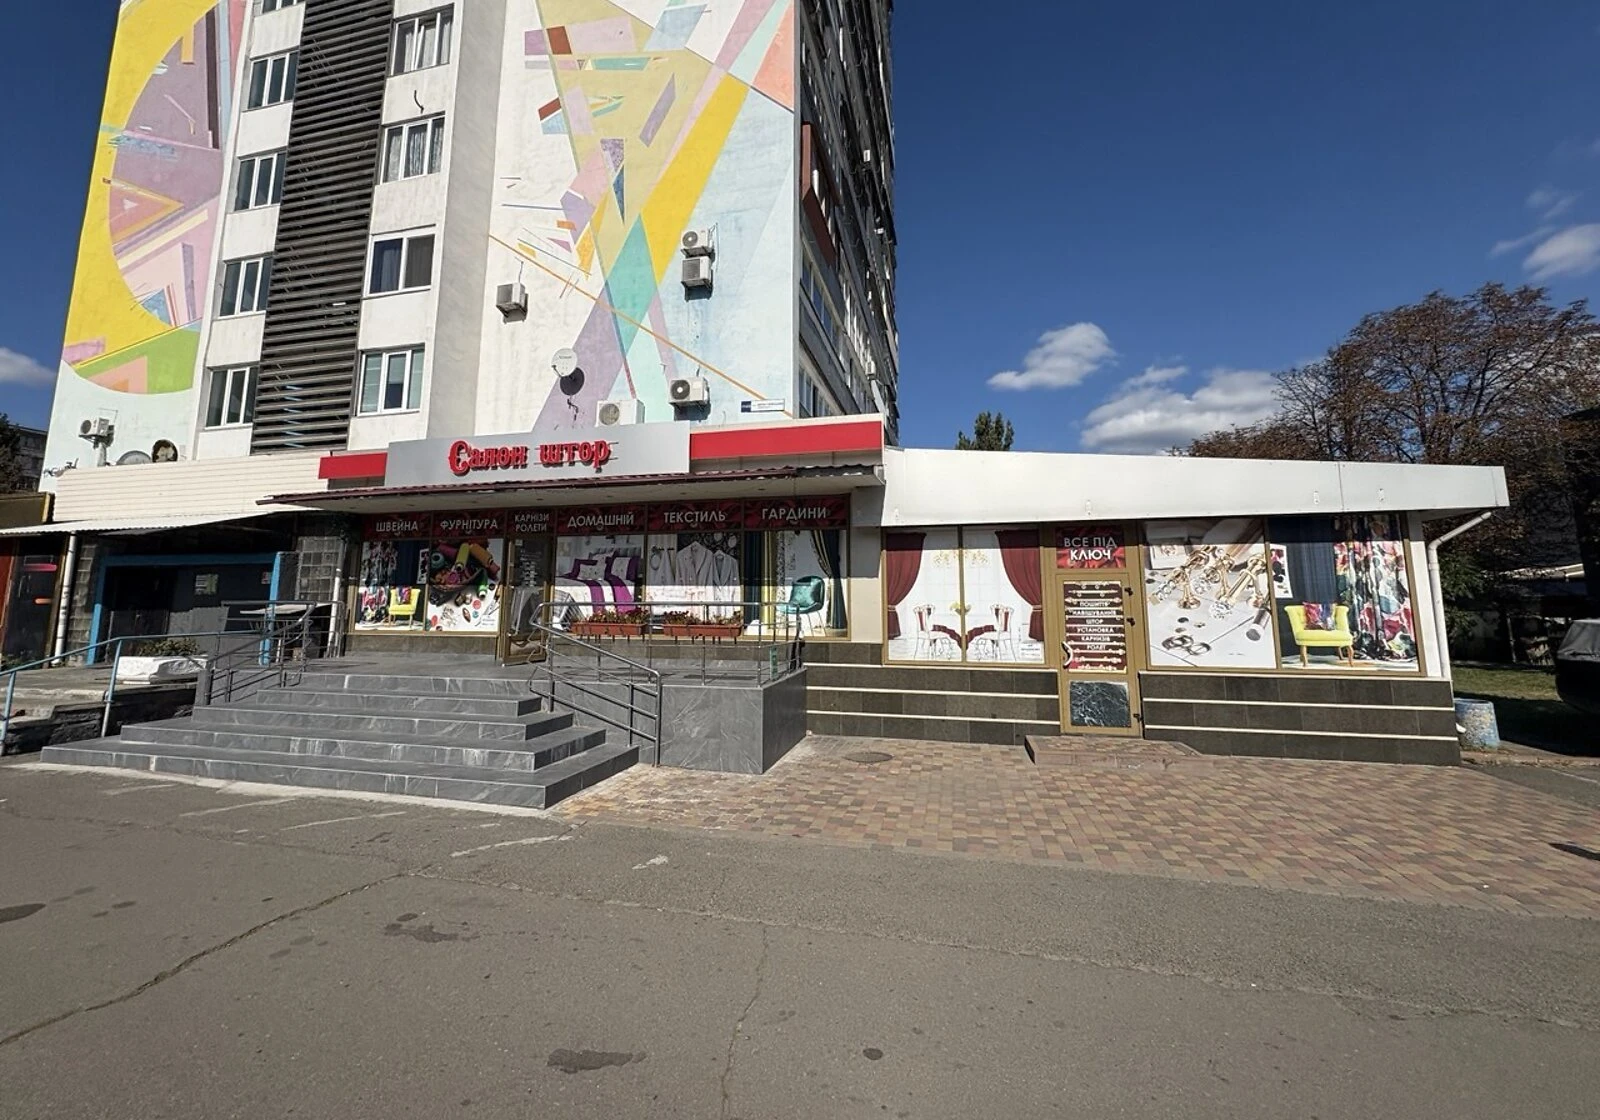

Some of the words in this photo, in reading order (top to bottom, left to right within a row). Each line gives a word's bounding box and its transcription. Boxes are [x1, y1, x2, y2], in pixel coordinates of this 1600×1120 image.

[448, 440, 528, 476] Салон
[539, 440, 611, 472] штор
[514, 513, 549, 523] КАРНІЗИ
[567, 511, 635, 528] ДОМАШНІЙ
[663, 511, 727, 524] ТЕКСТИЛЬ
[761, 507, 827, 522] ГАРДИНИ
[375, 519, 418, 532] ШВЕЙНА
[440, 519, 498, 531] ФУРНІТУРА
[515, 523, 547, 533] РОЛЕТИ
[1064, 537, 1089, 547] ВСЕ
[1093, 537, 1118, 549] ПІД
[1070, 549, 1111, 560] КЛЮЧ
